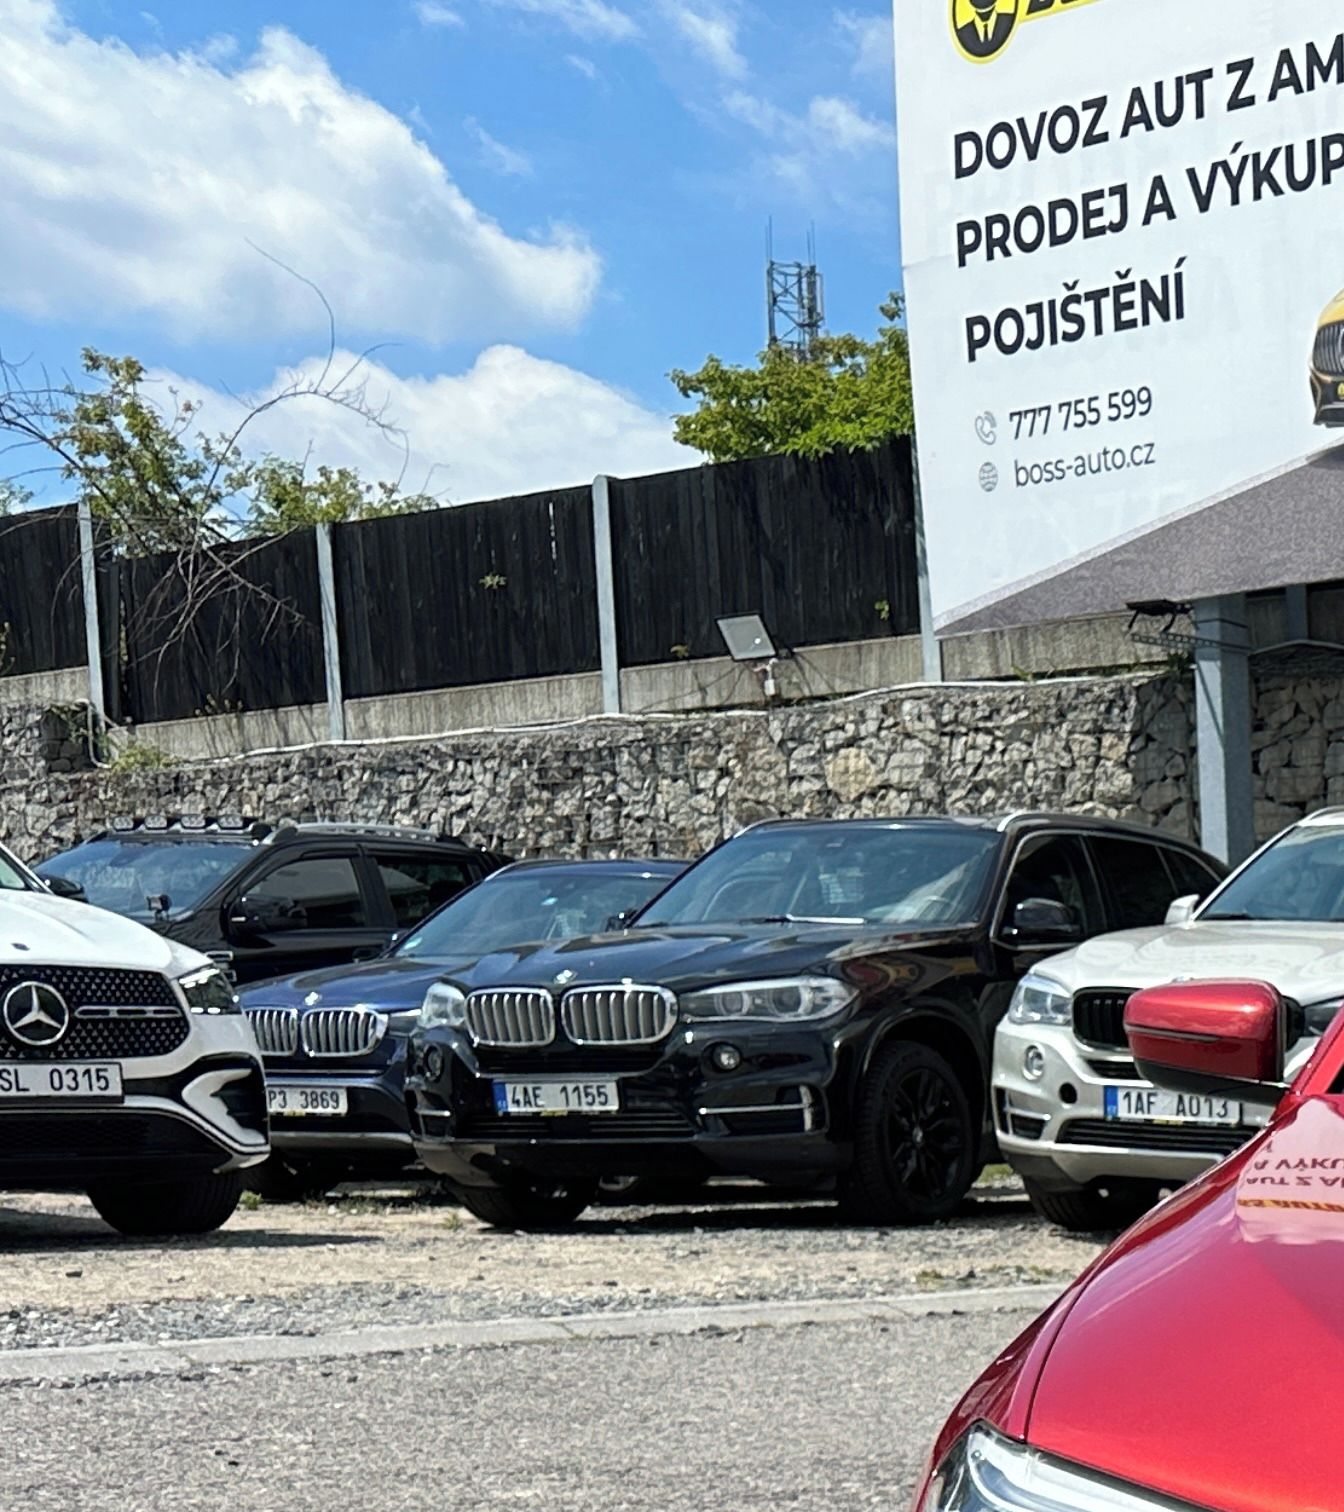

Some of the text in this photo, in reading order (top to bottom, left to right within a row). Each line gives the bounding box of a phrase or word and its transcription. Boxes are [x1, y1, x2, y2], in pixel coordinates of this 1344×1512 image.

[954, 95, 1110, 180] DOVOZ
[1119, 67, 1213, 140] AUT
[1226, 57, 1255, 112] Z
[956, 182, 1129, 268] PRODEJ
[1142, 174, 1177, 226] A
[966, 256, 1187, 363] POJIŠTĚNÍ
[1009, 386, 1152, 440] 777 755 599
[1014, 442, 1156, 488] boss-auto.cz
[49, 1068, 110, 1092] 0315
[300, 1090, 339, 1110] 3869
[511, 1085, 609, 1108] 4AE 1155
[1123, 1091, 1158, 1115] 1AF
